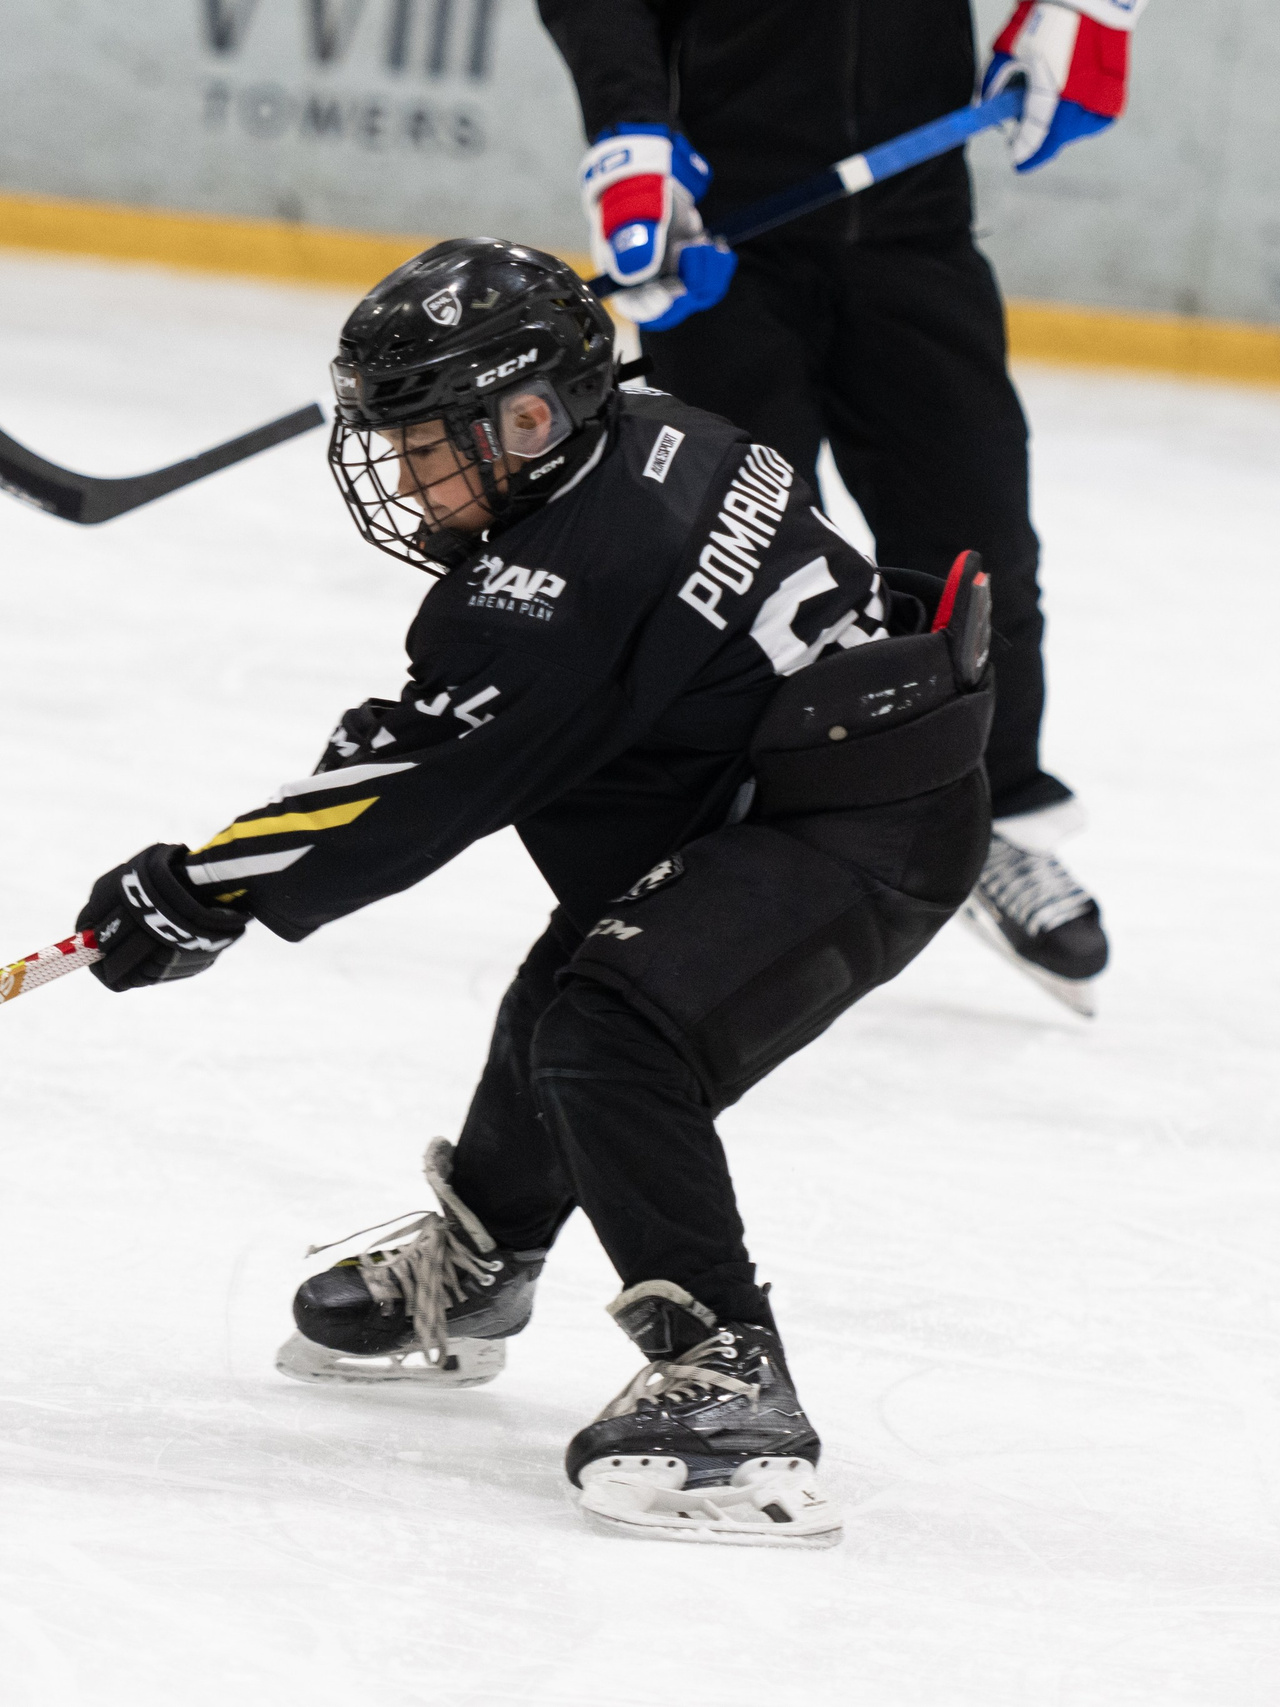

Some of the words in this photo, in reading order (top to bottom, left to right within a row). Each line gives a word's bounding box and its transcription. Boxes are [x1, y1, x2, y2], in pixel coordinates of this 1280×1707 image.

[475, 347, 539, 388] CCM
[529, 455, 566, 481] CCM
[467, 594, 516, 612] ARENA
[519, 601, 555, 622] PLAY
